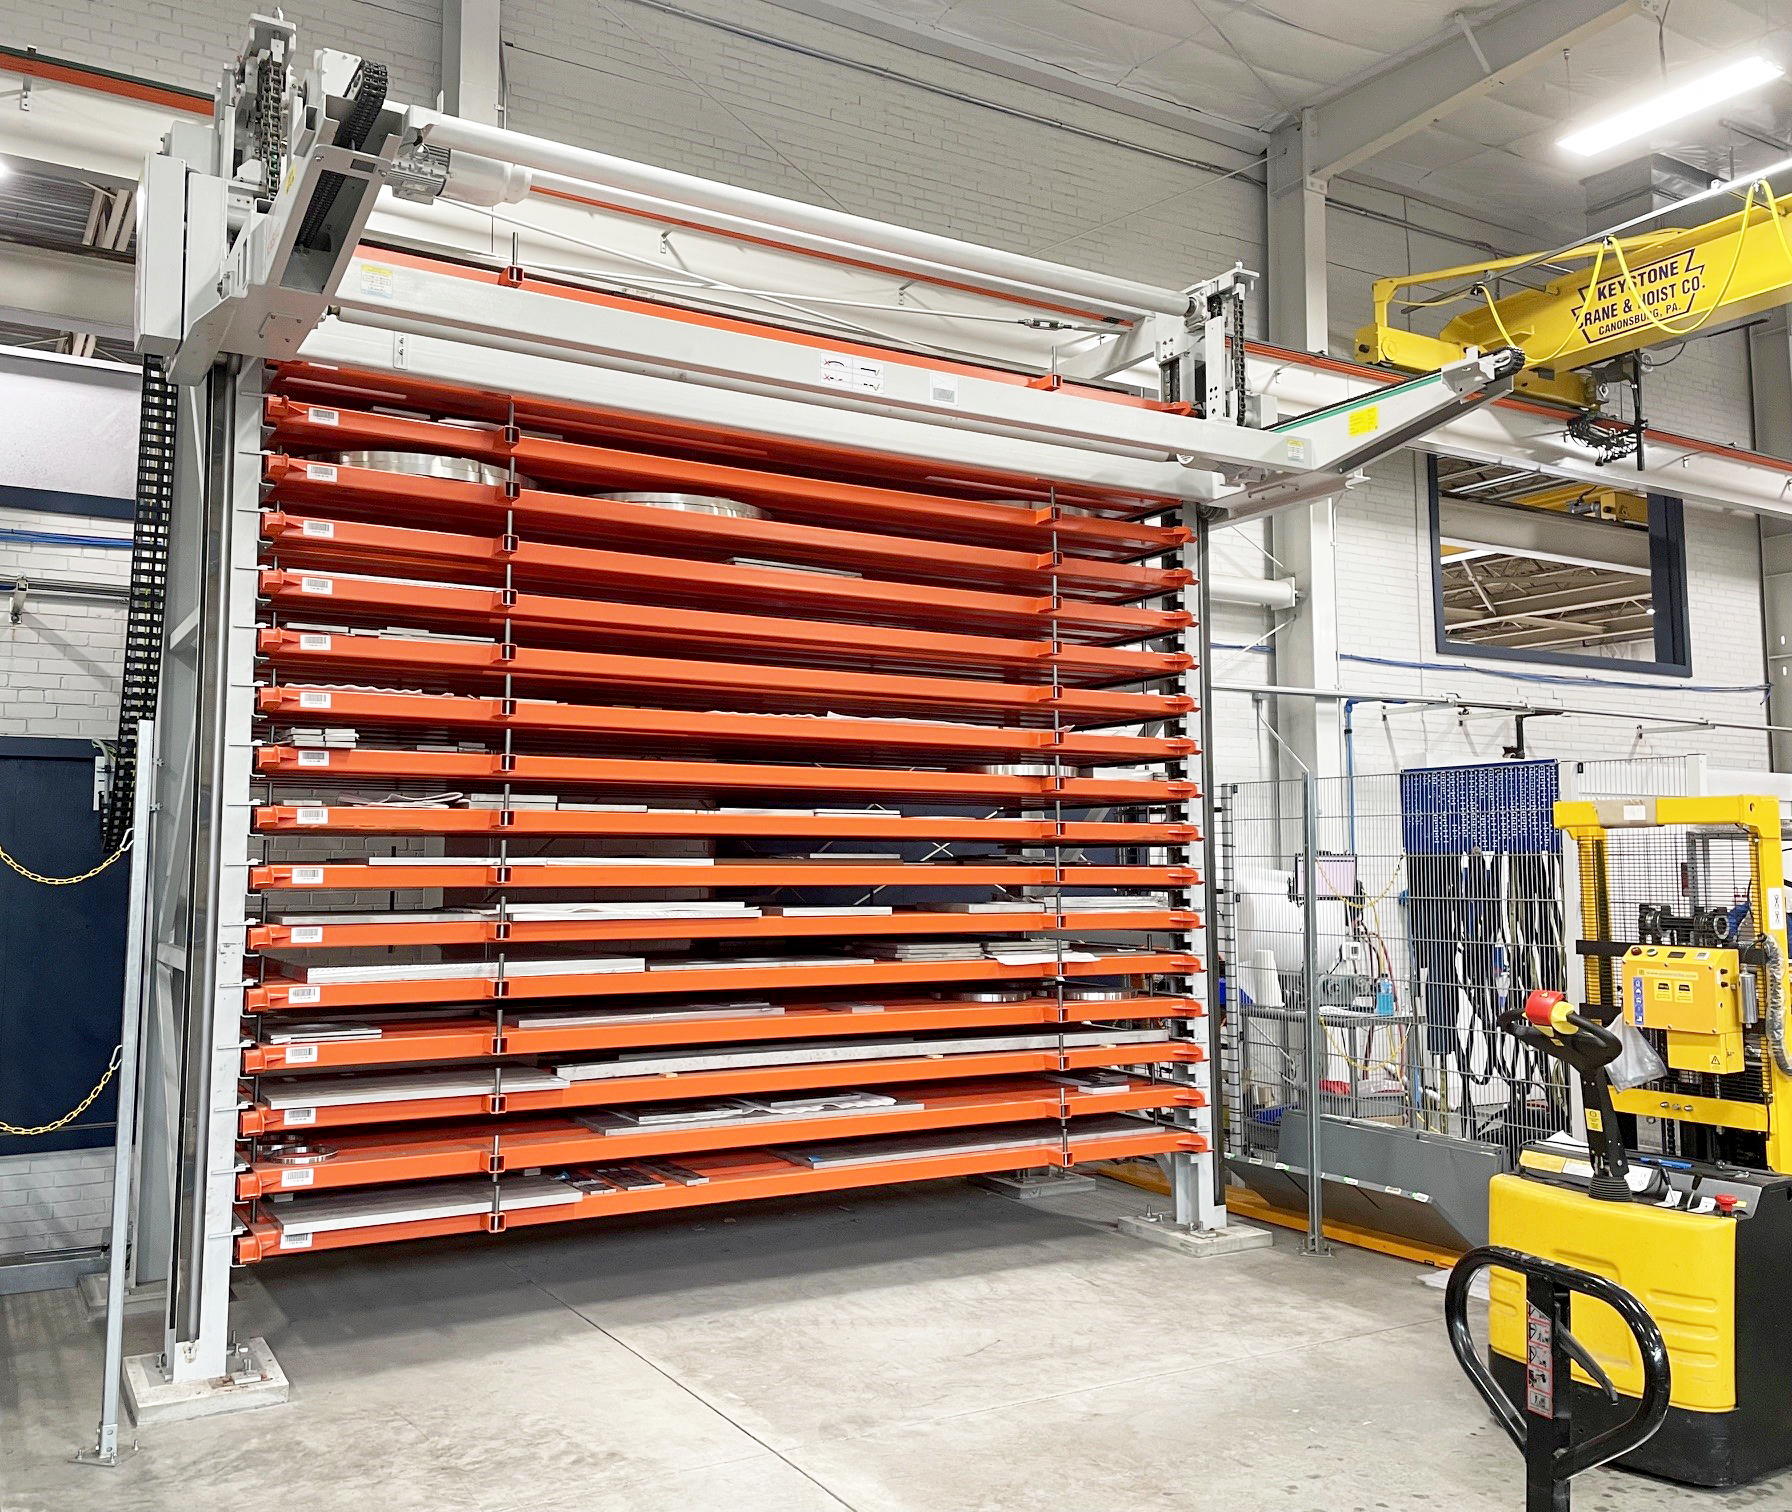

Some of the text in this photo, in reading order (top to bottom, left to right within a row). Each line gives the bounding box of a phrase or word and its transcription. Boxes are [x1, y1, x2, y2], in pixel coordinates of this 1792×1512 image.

[1597, 260, 1679, 301] KEYSTONE
[1623, 298, 1632, 314] &
[1682, 275, 1706, 294] CO.
[1598, 302, 1682, 335] CANONSBUG, PA.
